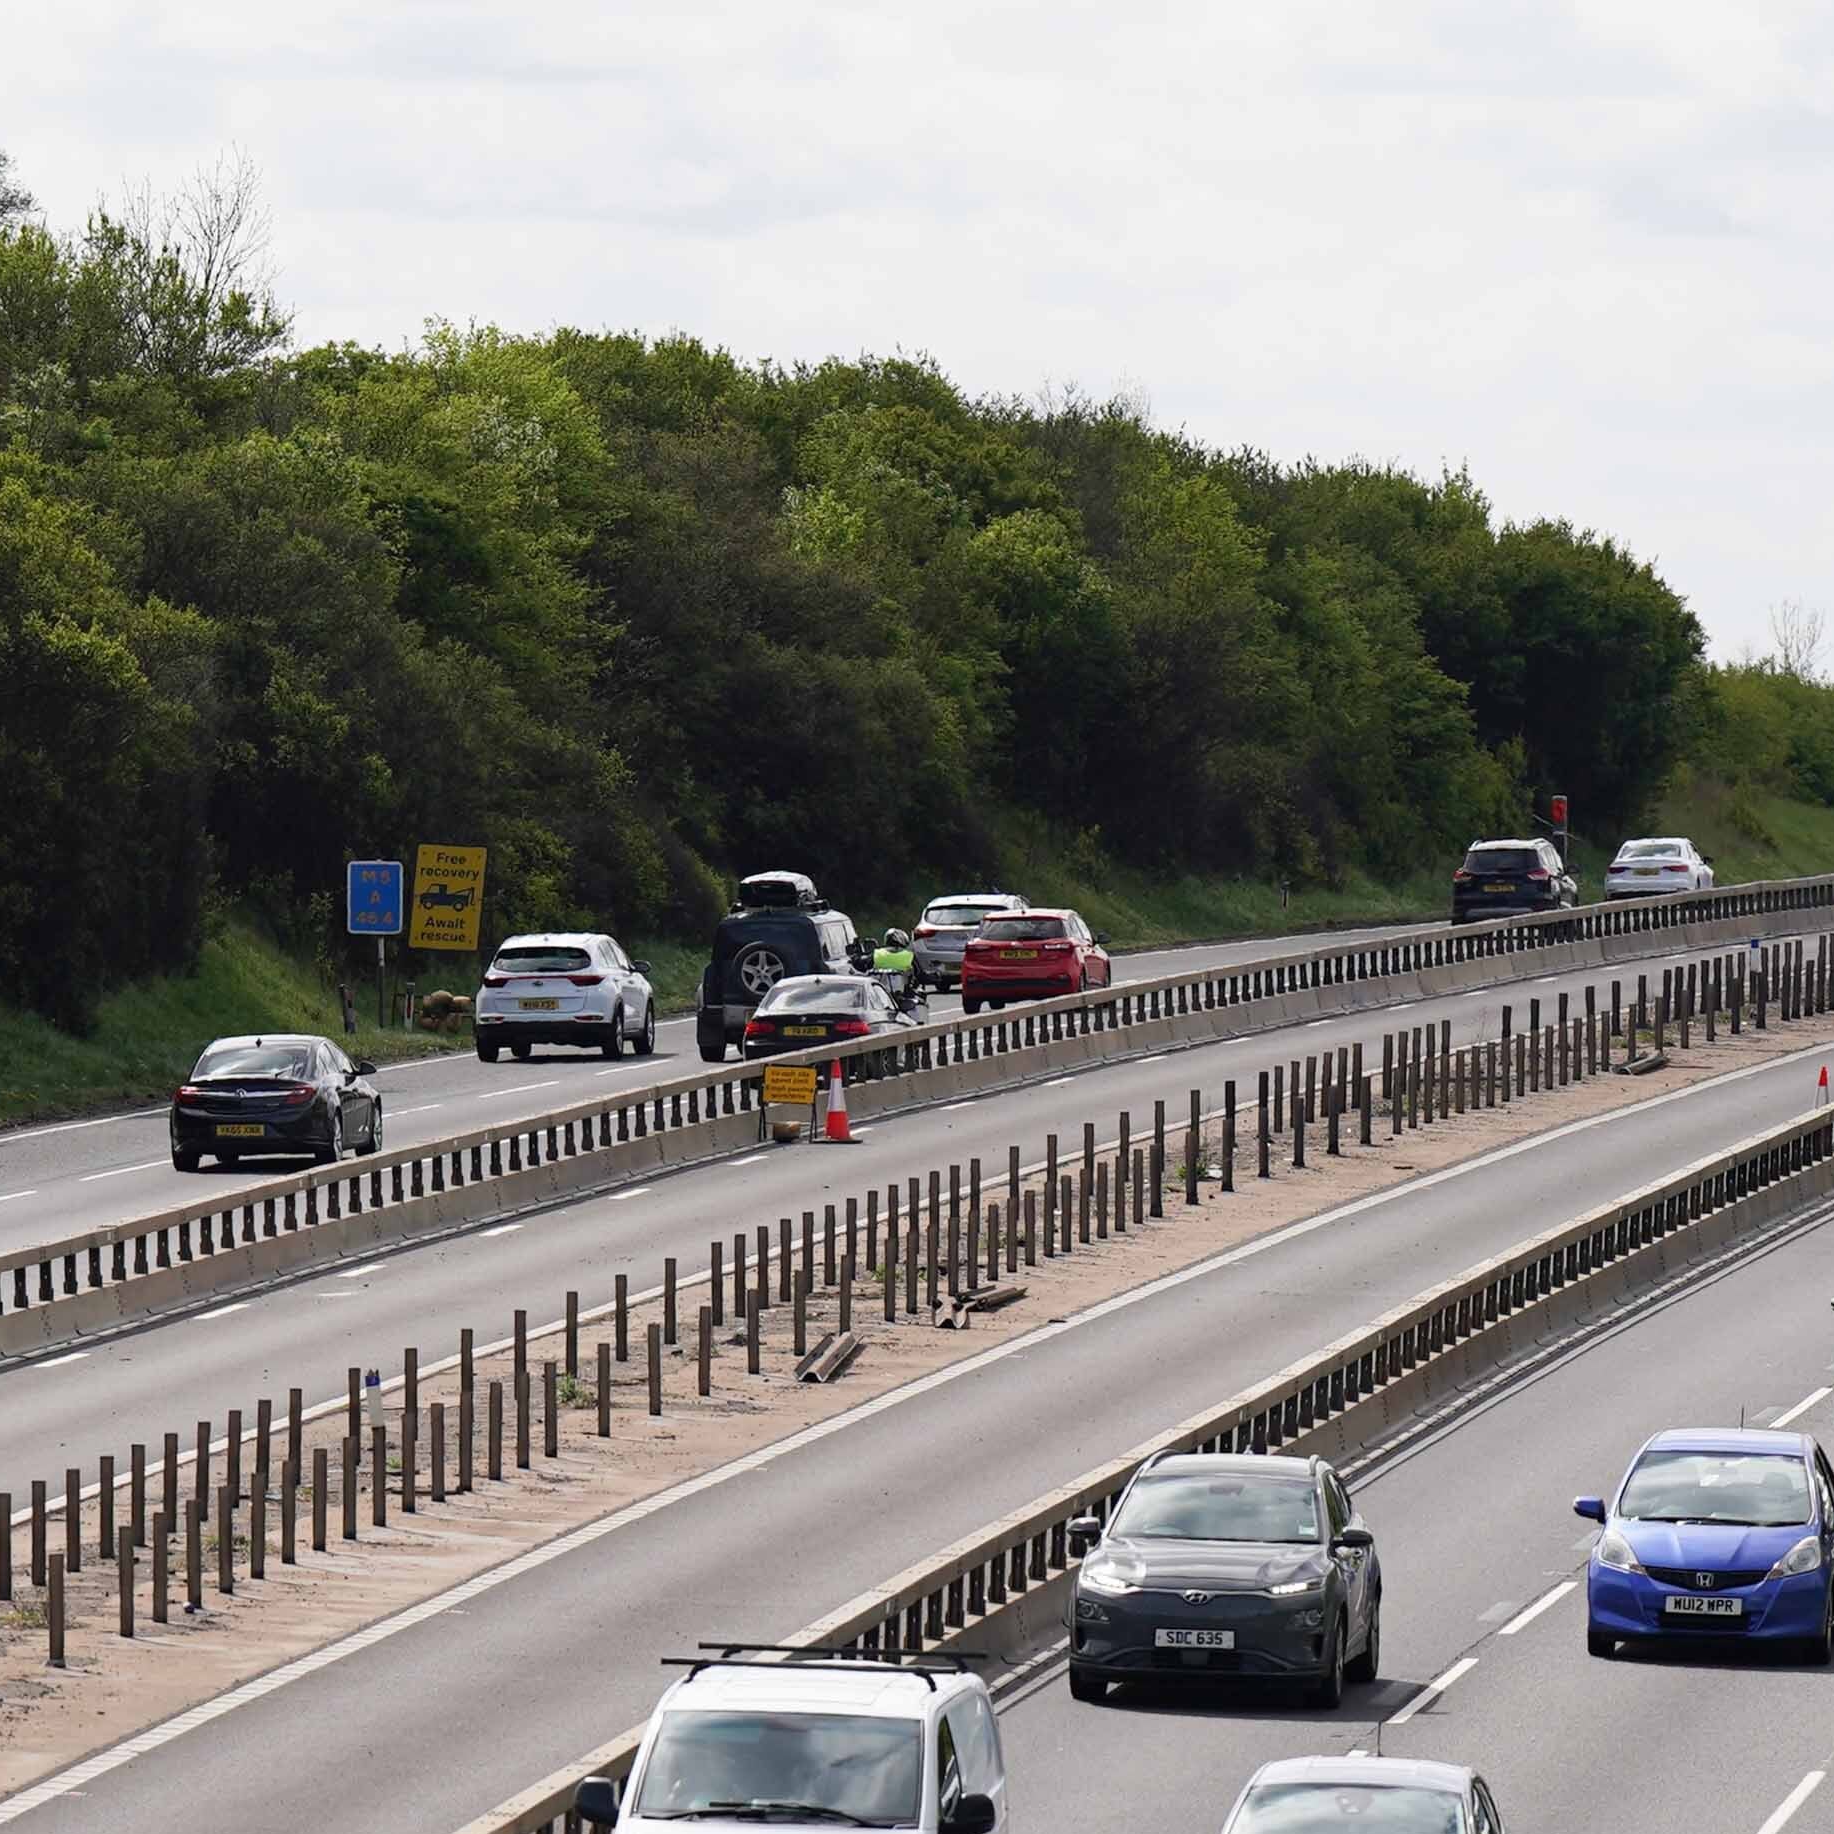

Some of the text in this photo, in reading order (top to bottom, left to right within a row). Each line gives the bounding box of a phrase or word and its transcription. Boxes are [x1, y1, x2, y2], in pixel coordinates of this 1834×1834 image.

[436, 852, 467, 864] Free
[420, 867, 480, 881] recovery
[424, 916, 466, 929] Await
[421, 931, 467, 943] rescue
[1166, 1631, 1193, 1644] SDC
